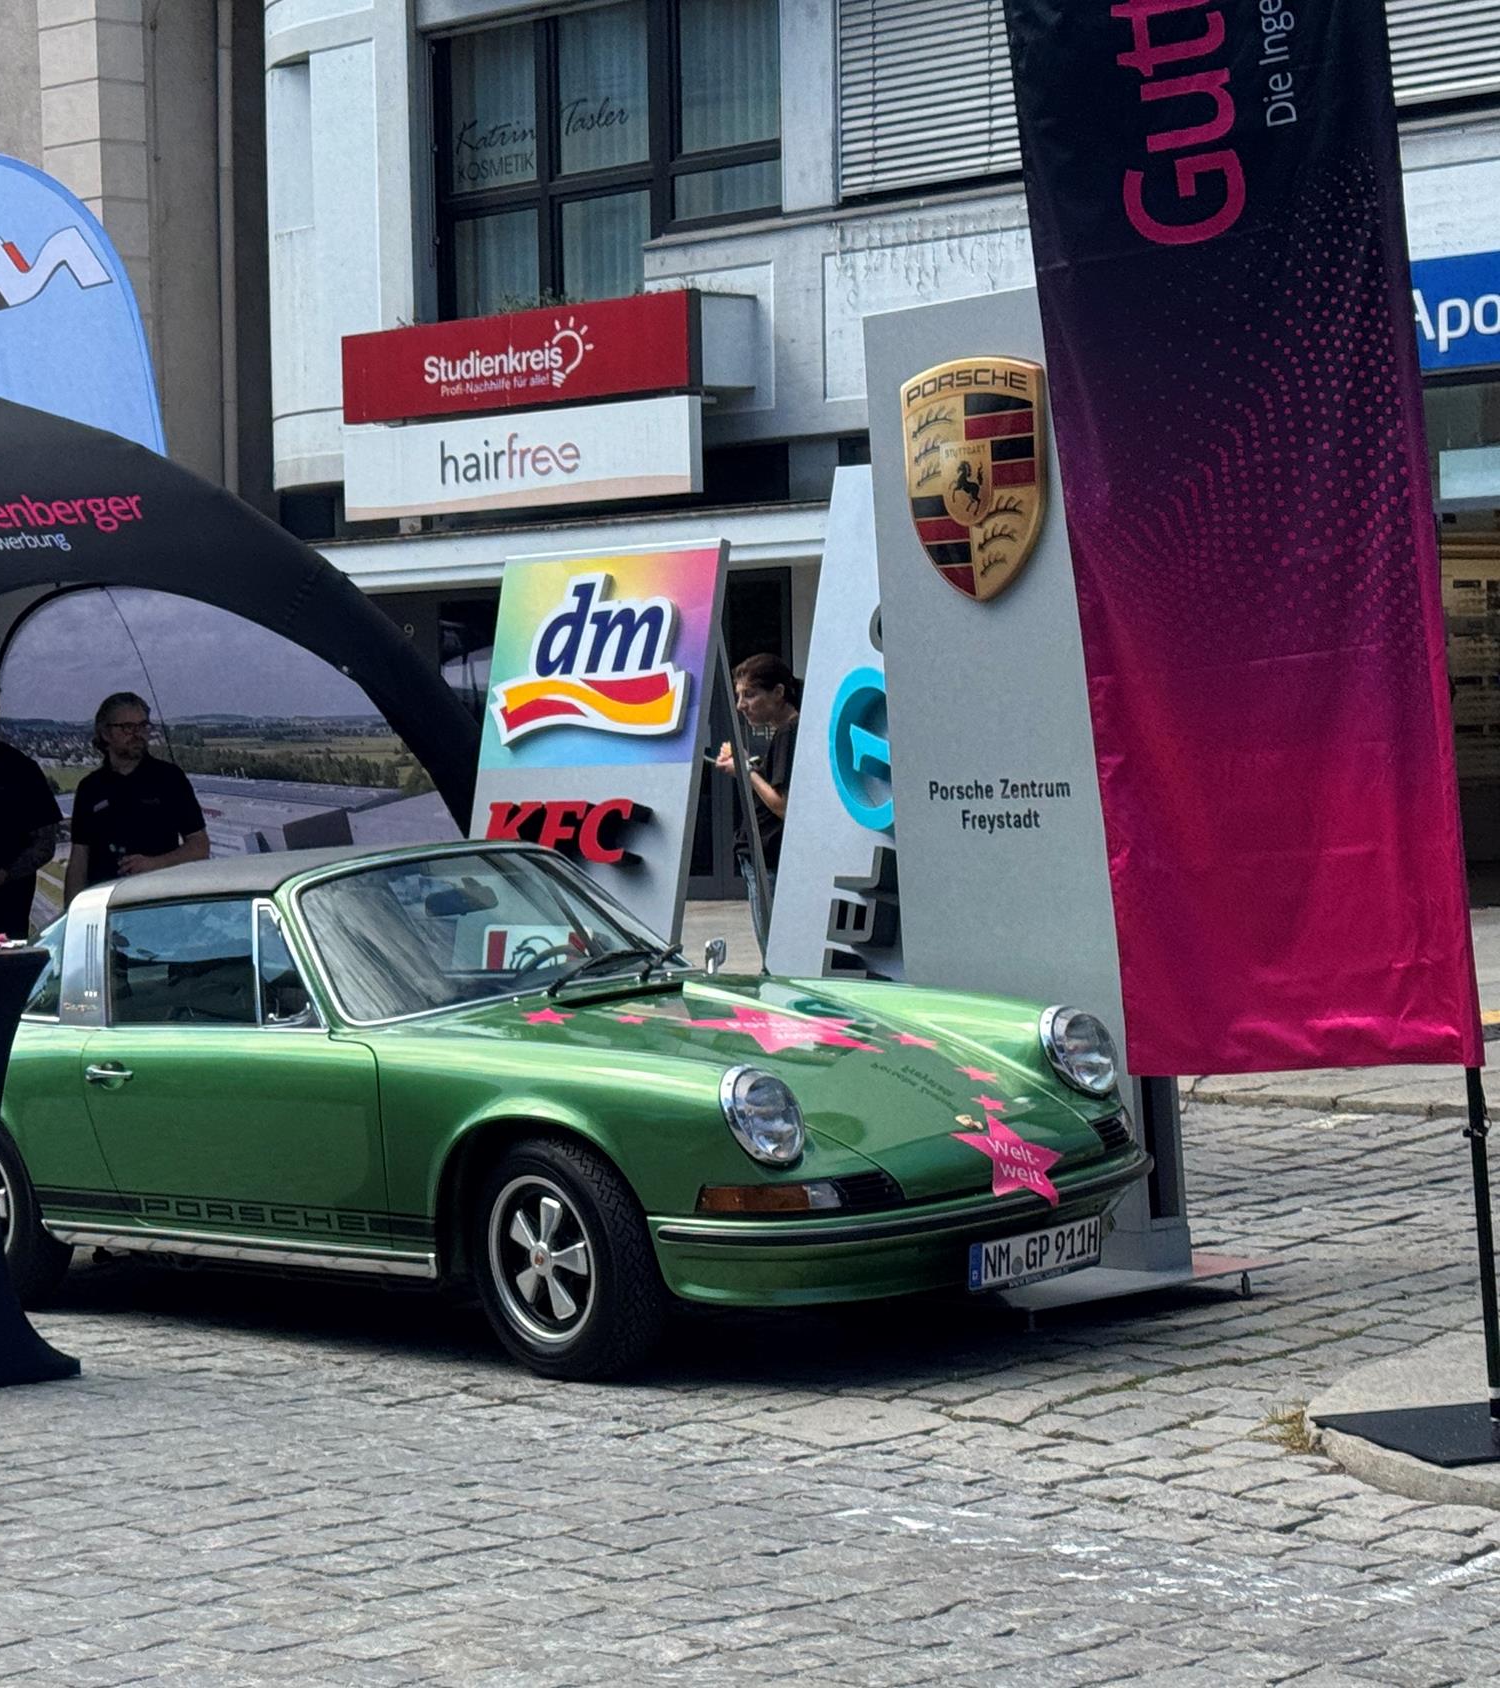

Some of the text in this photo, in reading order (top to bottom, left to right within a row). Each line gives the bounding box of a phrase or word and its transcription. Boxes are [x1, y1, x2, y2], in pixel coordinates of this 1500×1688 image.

[1263, 72, 1297, 127] Die
[456, 97, 629, 155] Katrin Tasler
[457, 152, 535, 183] KOSMETIK
[424, 341, 563, 384] Studienkreis
[441, 378, 511, 397] Profi-Nachhilfe
[513, 375, 528, 388] für
[906, 368, 1028, 408] PORSCHE
[440, 432, 581, 485] hairfree
[535, 582, 666, 678] dm
[929, 779, 1071, 800] Porsche Zentrum
[485, 798, 634, 864] KFC
[961, 808, 1041, 834] Freystadt
[986, 1137, 1041, 1165] Welt-
[145, 1198, 367, 1232] PORSCHE
[984, 1243, 1011, 1280] NM
[1025, 1234, 1050, 1271] GP
[1055, 1220, 1098, 1265] 911H
